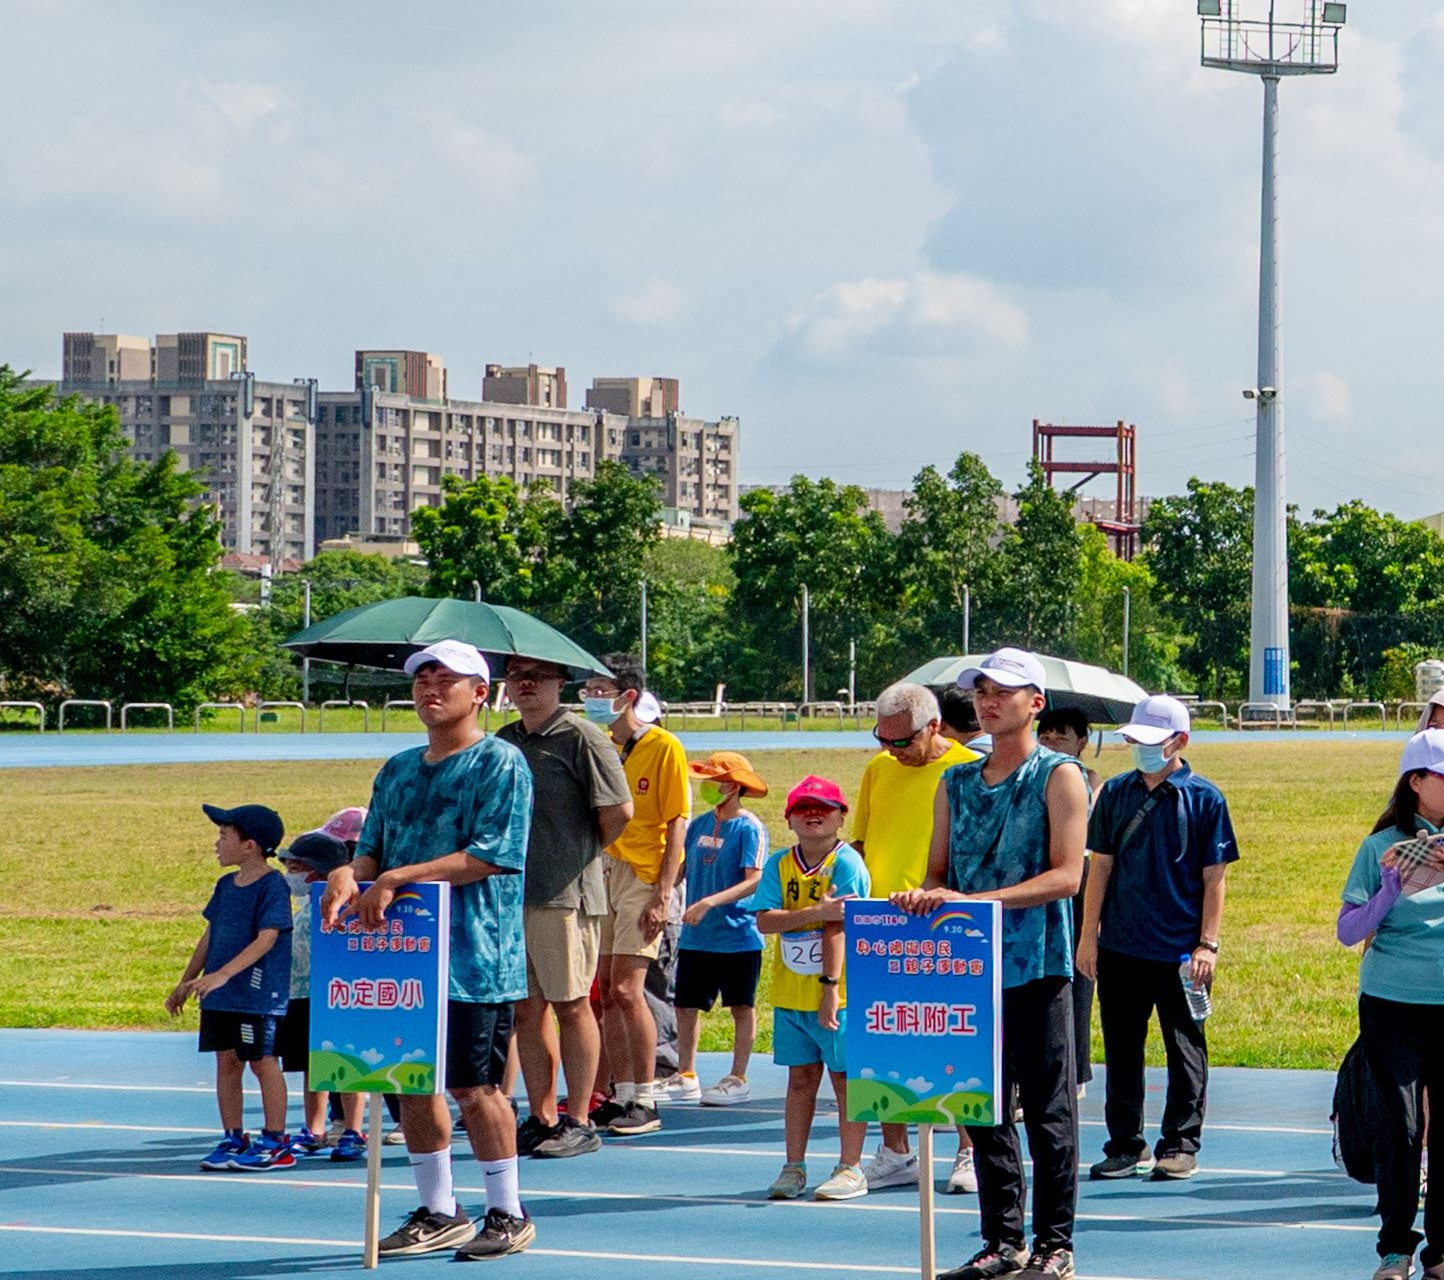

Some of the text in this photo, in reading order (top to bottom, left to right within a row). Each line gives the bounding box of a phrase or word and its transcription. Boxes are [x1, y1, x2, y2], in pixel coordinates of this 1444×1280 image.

[943, 925, 963, 934] 9.20
[784, 941, 823, 965] 126
[328, 976, 425, 1010] 內定國小
[866, 1001, 977, 1036] 北科附工
